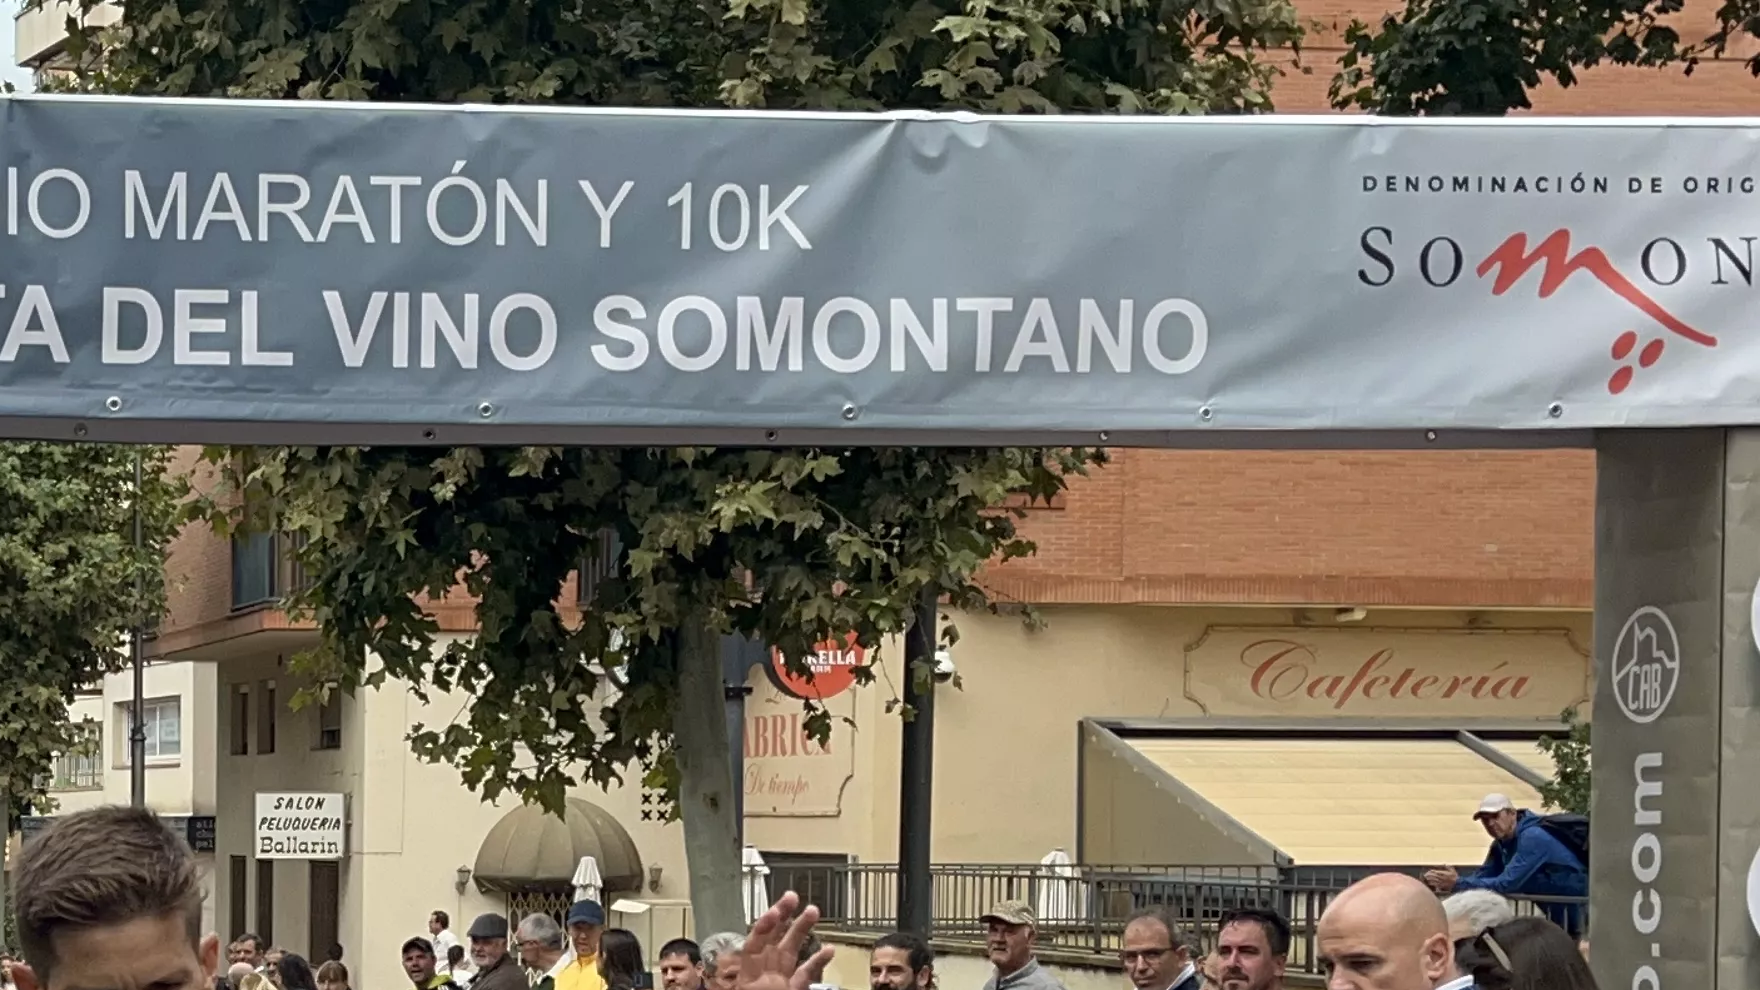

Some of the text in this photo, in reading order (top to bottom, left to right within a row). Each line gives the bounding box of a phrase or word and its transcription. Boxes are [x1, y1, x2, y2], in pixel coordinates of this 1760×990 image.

[124, 160, 547, 247] MARATÓN
[579, 180, 634, 248] Y
[667, 182, 812, 252] 10K
[1362, 172, 1759, 194] DENOMINACIÓN DE ORIG
[101, 287, 293, 366] DEL
[322, 290, 557, 371] VINO
[590, 294, 1208, 374] SOMONTANO
[1241, 639, 1531, 709] Cafetería
[1627, 663, 1662, 711] CAB
[258, 816, 341, 831] PELUQUERIA
[273, 796, 326, 811] SALON
